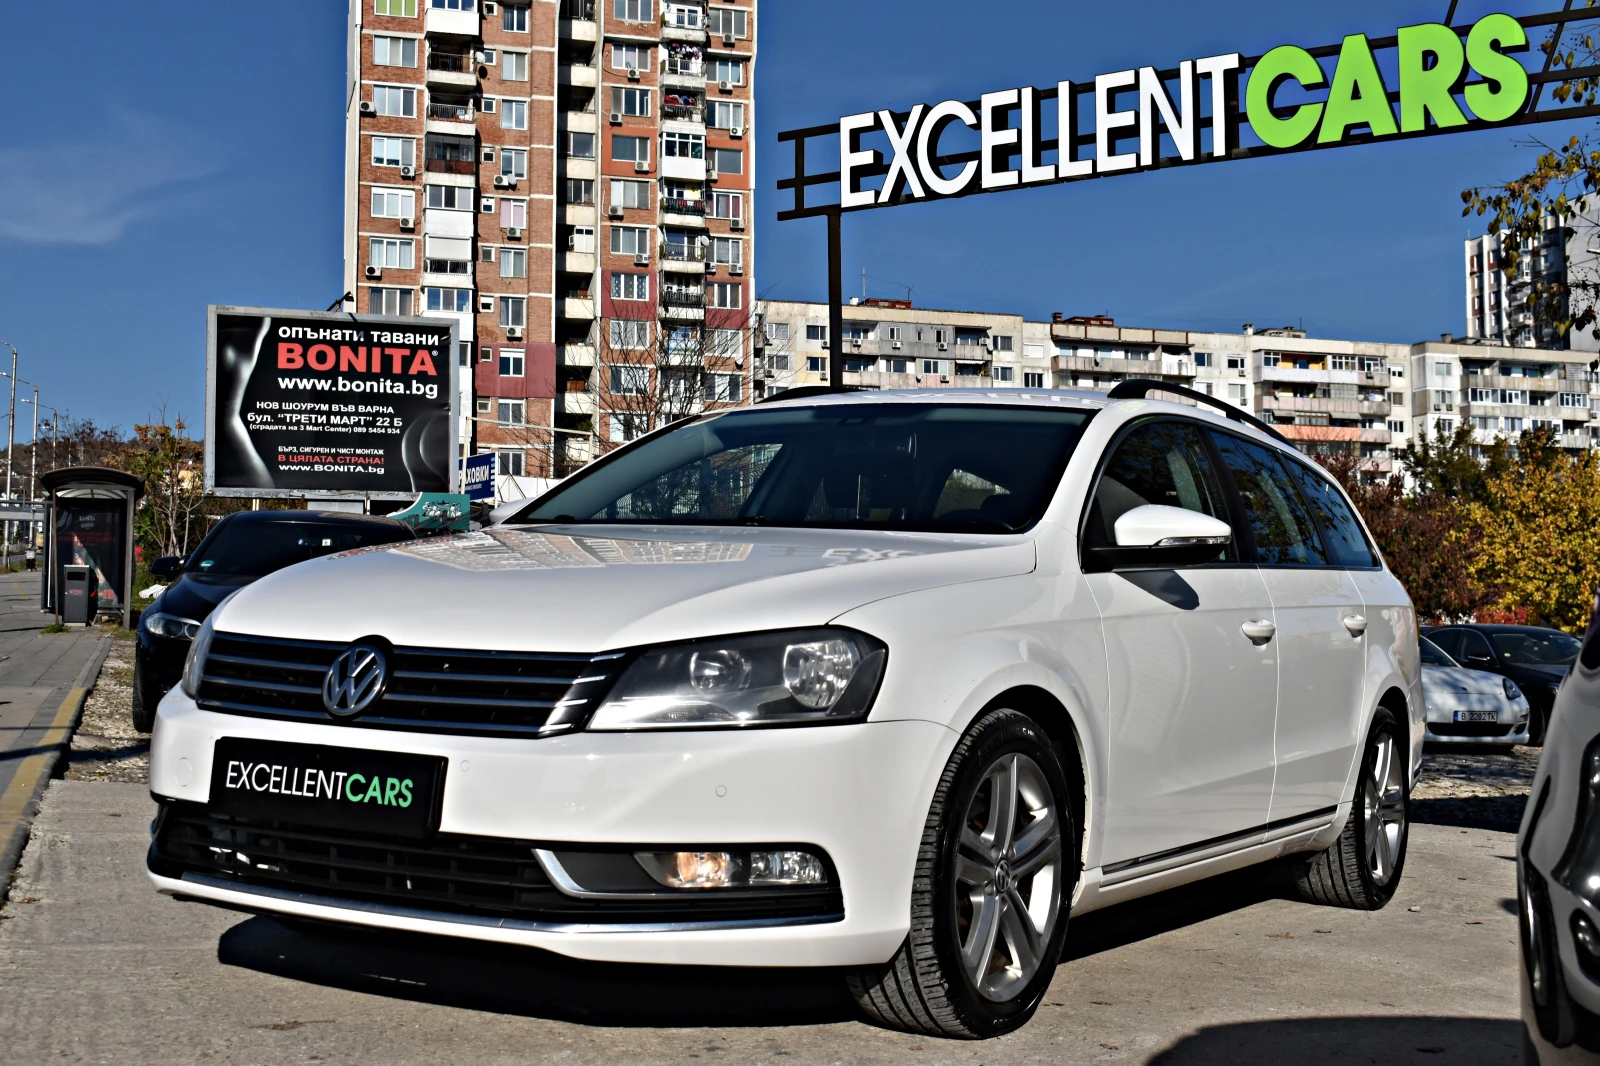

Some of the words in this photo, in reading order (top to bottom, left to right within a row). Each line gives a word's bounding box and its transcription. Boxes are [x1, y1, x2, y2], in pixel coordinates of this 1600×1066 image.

[370, 331, 439, 346] тавани
[277, 376, 438, 399] www.bonita.bg
[256, 401, 279, 410] НОВ
[282, 402, 329, 412] ШОУРУМ
[331, 404, 356, 412] ВЪВ
[358, 405, 395, 414] ВАРНА
[247, 412, 274, 423] бул.
[376, 417, 390, 426] 22
[394, 417, 403, 427] Б
[250, 423, 287, 431] (сградата
[299, 446, 330, 454] СИГУРЕН
[278, 454, 286, 462] В
[289, 455, 334, 463] ЦЯЛАТА
[337, 456, 385, 464] СТРАНА!
[278, 464, 385, 475] www.BONITA.bg
